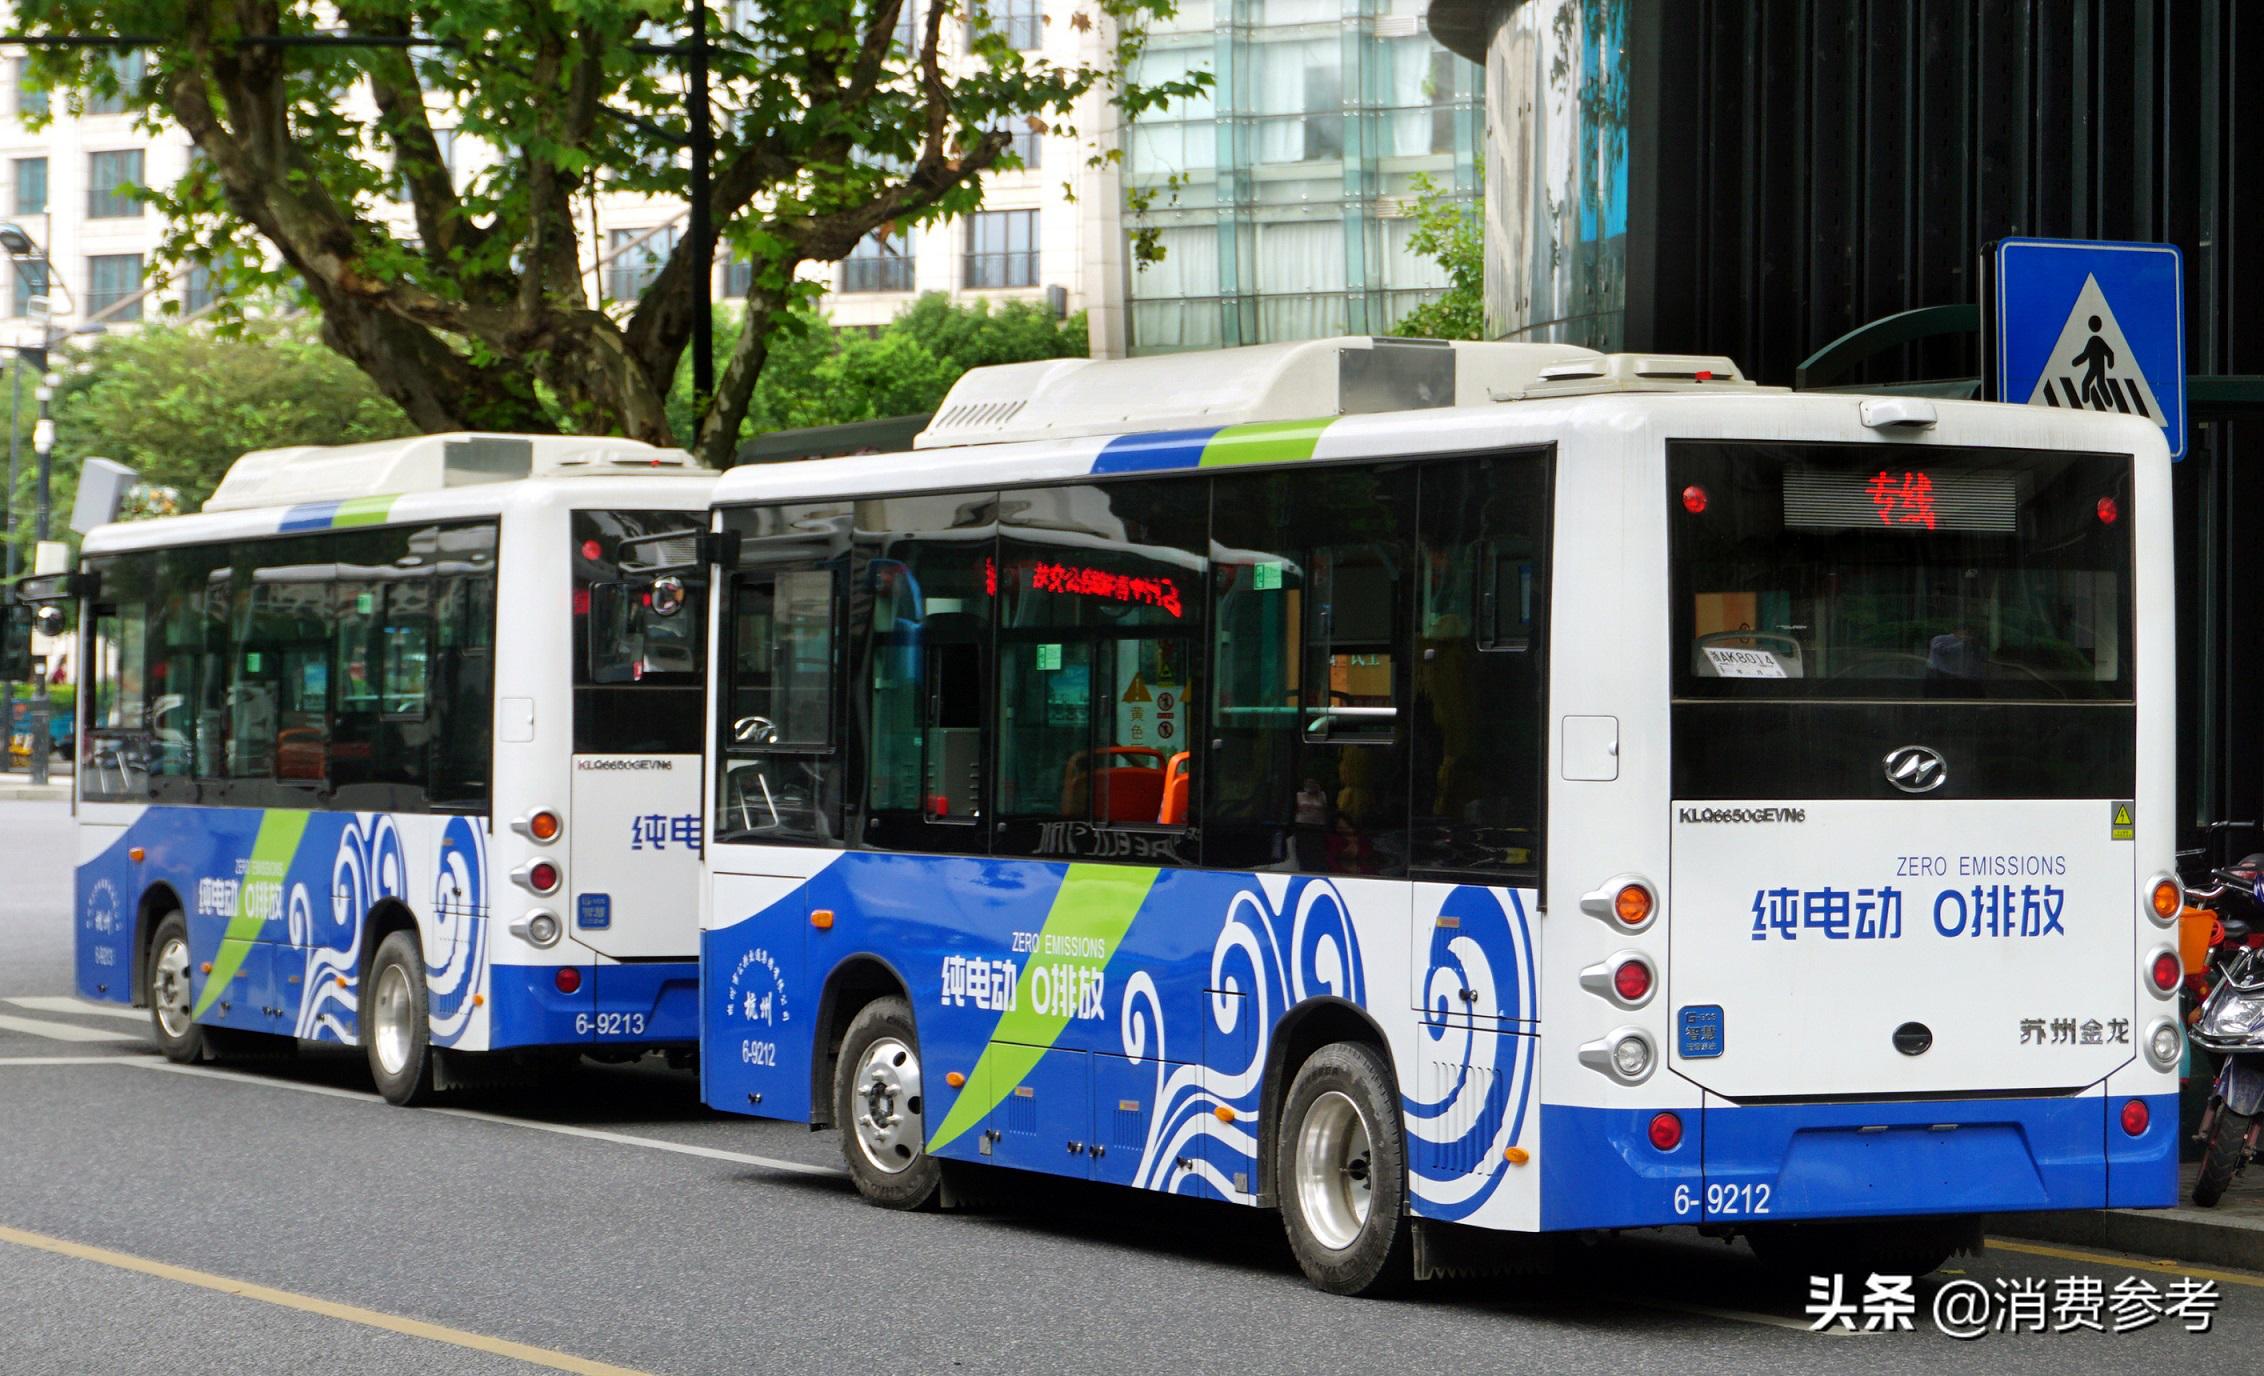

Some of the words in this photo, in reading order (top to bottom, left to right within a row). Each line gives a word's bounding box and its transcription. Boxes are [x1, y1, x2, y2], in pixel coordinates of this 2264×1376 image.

[1864, 471, 1935, 531] 专线
[1679, 807, 1806, 824] KLQ6650GEVN6
[1896, 856, 1948, 877] ZERO
[1959, 855, 2067, 877] EMISSIONS
[199, 877, 239, 917] 纯电动
[1751, 886, 1903, 941] 纯电动
[1011, 931, 1041, 953] ZERO
[1044, 934, 1105, 960] EMISSIONS
[941, 955, 1018, 1012] 纯电动
[744, 990, 774, 1028] 杭州
[575, 1013, 645, 1035] 6-9213
[2019, 1018, 2130, 1045] 苏州金龙
[742, 1039, 776, 1068] 6-9212
